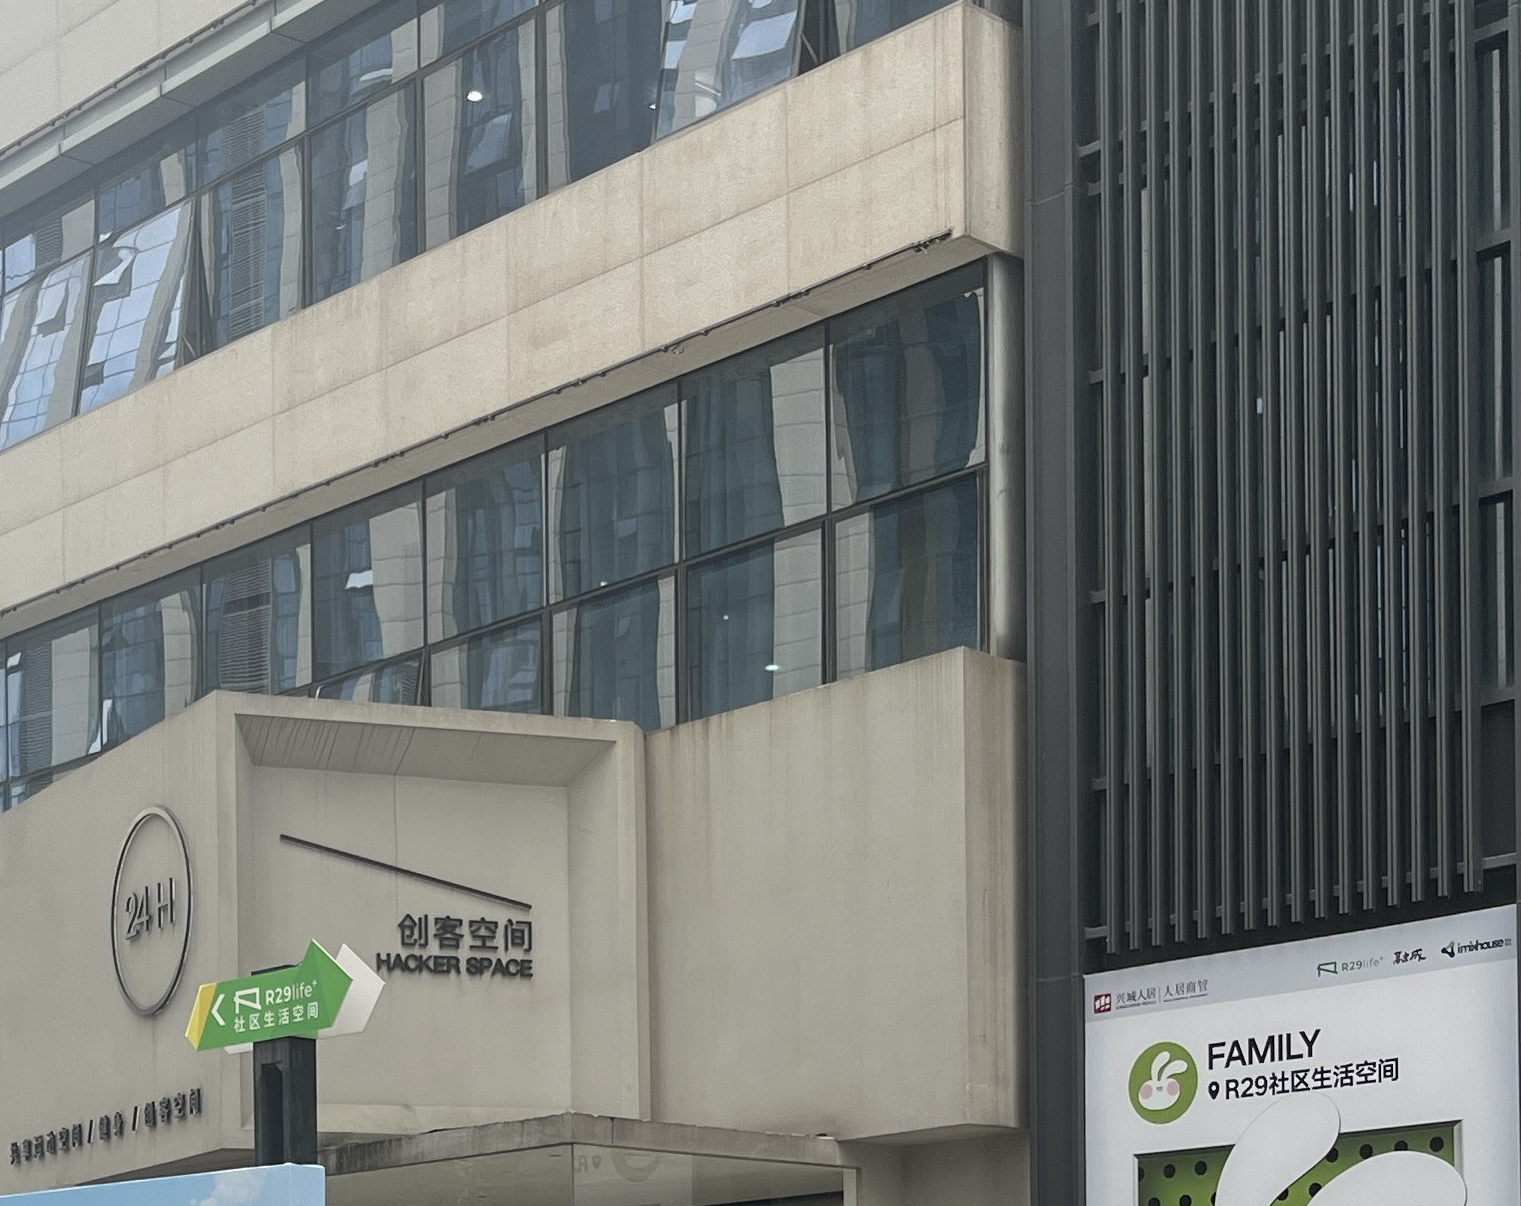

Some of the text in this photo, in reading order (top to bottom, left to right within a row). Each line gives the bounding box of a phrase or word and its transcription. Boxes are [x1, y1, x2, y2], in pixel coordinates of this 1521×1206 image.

[126, 877, 176, 941] 24H
[397, 913, 533, 953] 创客空间
[376, 952, 534, 978] HACKER SPACE
[233, 1001, 320, 1034] 社区生活空间
[1208, 1028, 1321, 1070] FAMILY
[1225, 1057, 1399, 1100] R29社区生活空间
